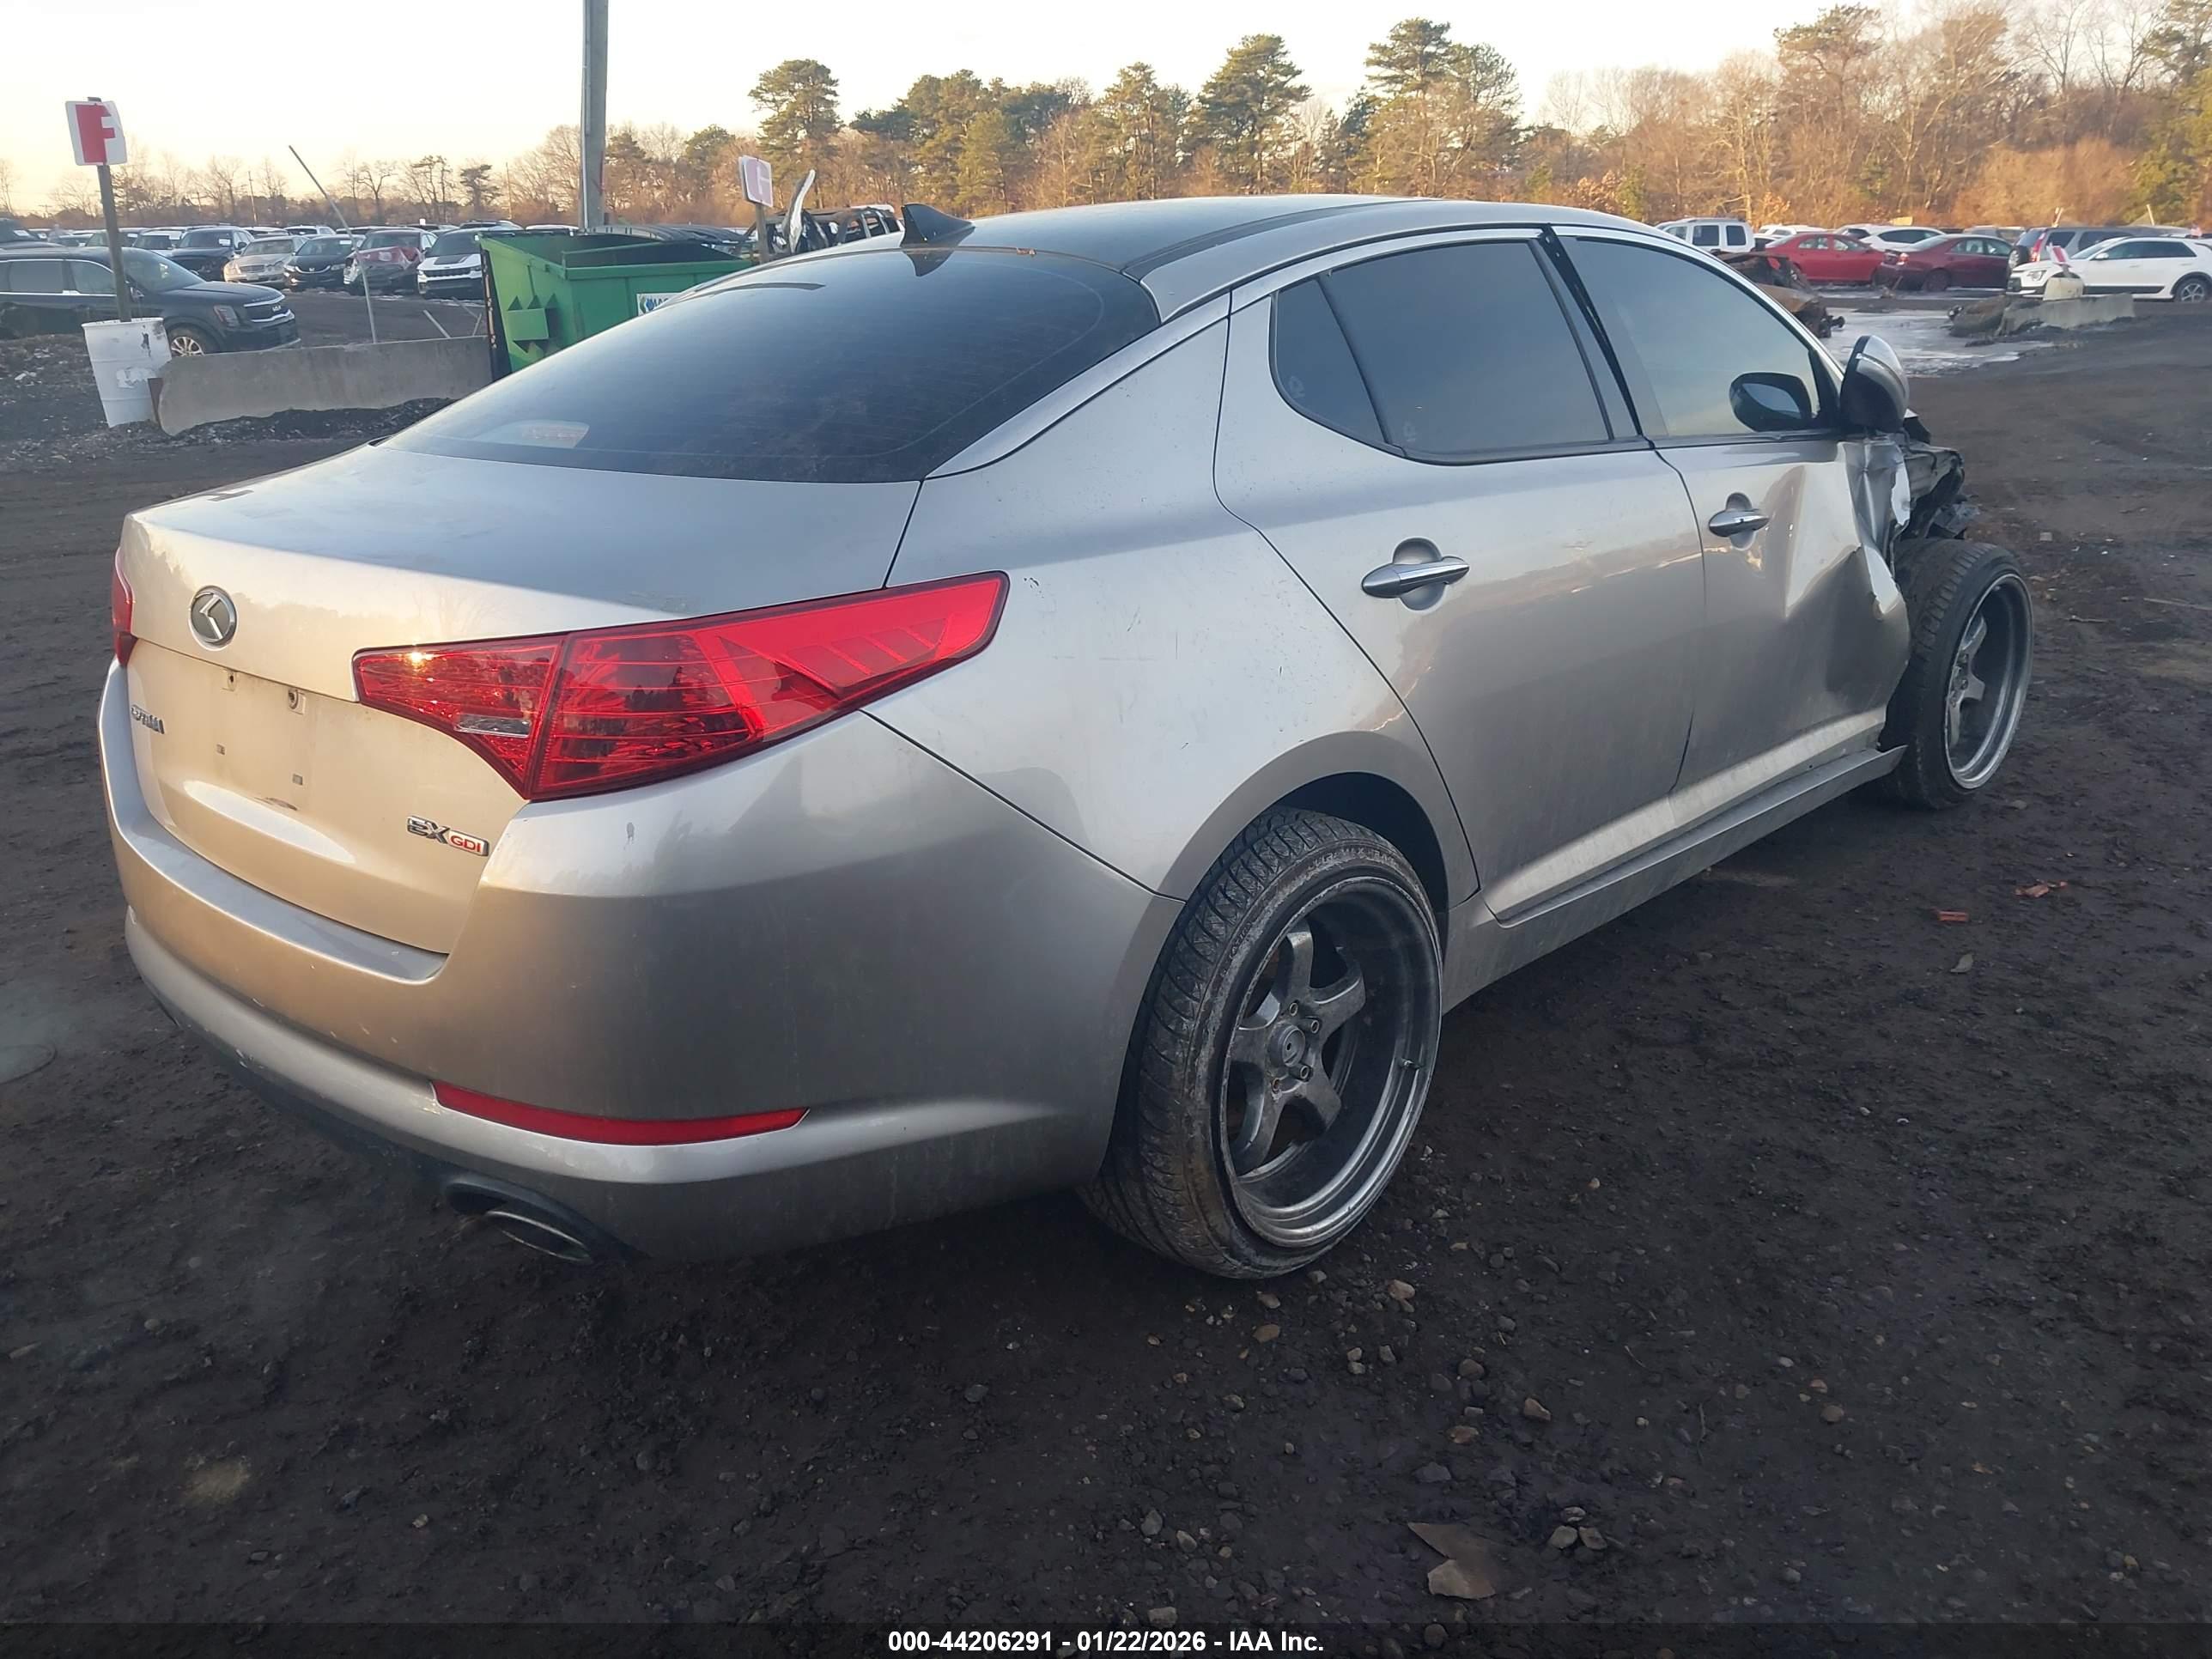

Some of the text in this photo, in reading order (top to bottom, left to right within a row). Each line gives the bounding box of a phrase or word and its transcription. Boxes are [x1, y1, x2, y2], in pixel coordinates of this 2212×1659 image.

[75, 104, 116, 164] F
[407, 816, 483, 854] EX GDI
